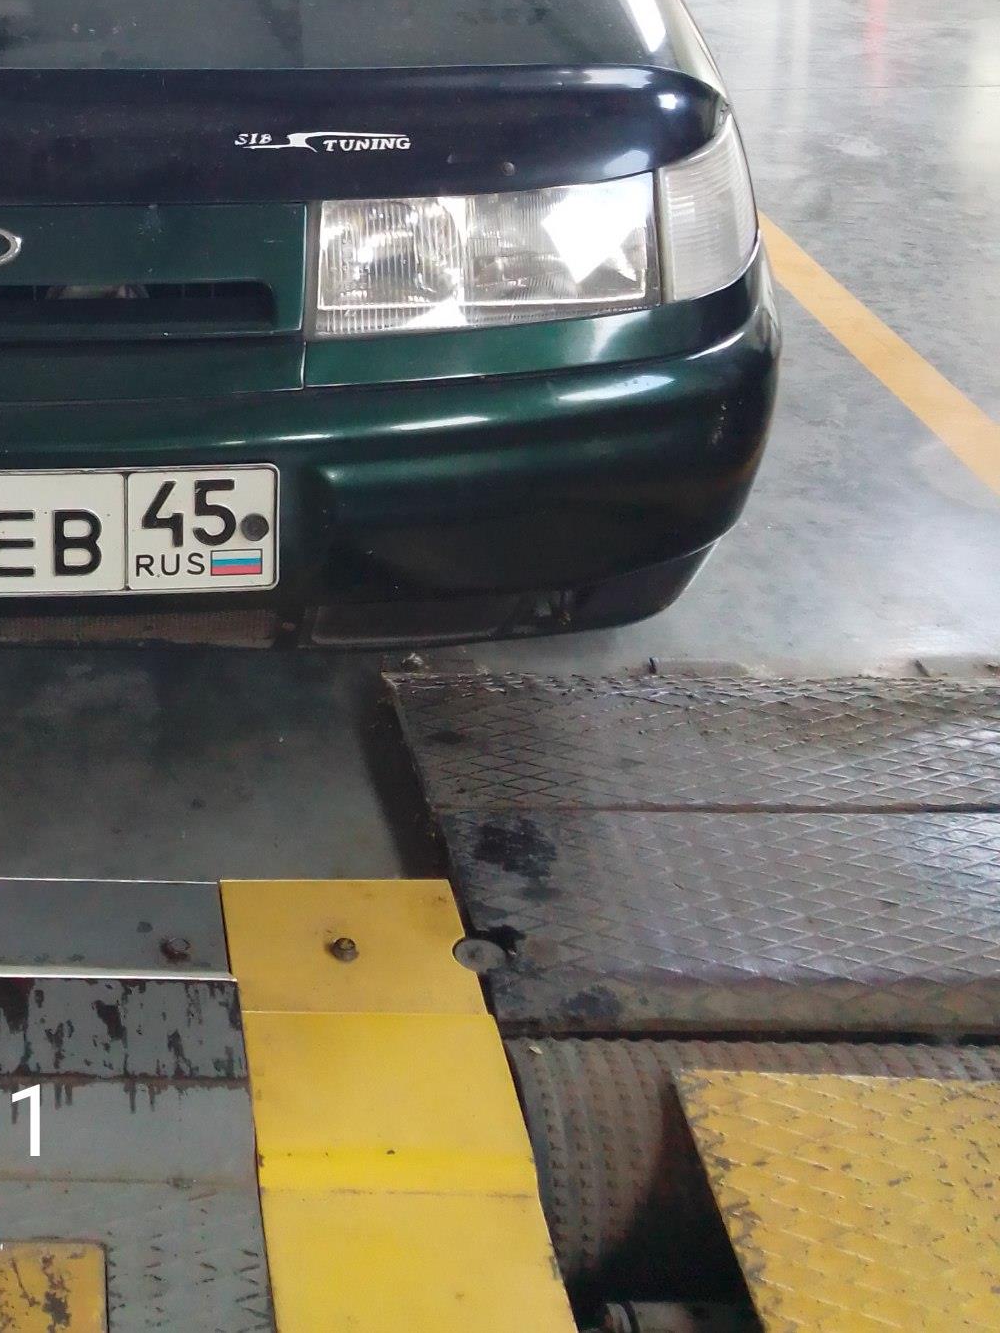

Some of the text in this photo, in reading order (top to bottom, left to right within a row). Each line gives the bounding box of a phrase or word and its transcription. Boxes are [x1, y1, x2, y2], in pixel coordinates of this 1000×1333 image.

[233, 132, 413, 153] SIB TUNING
[140, 479, 238, 549] 45
[134, 551, 207, 579] RUS
